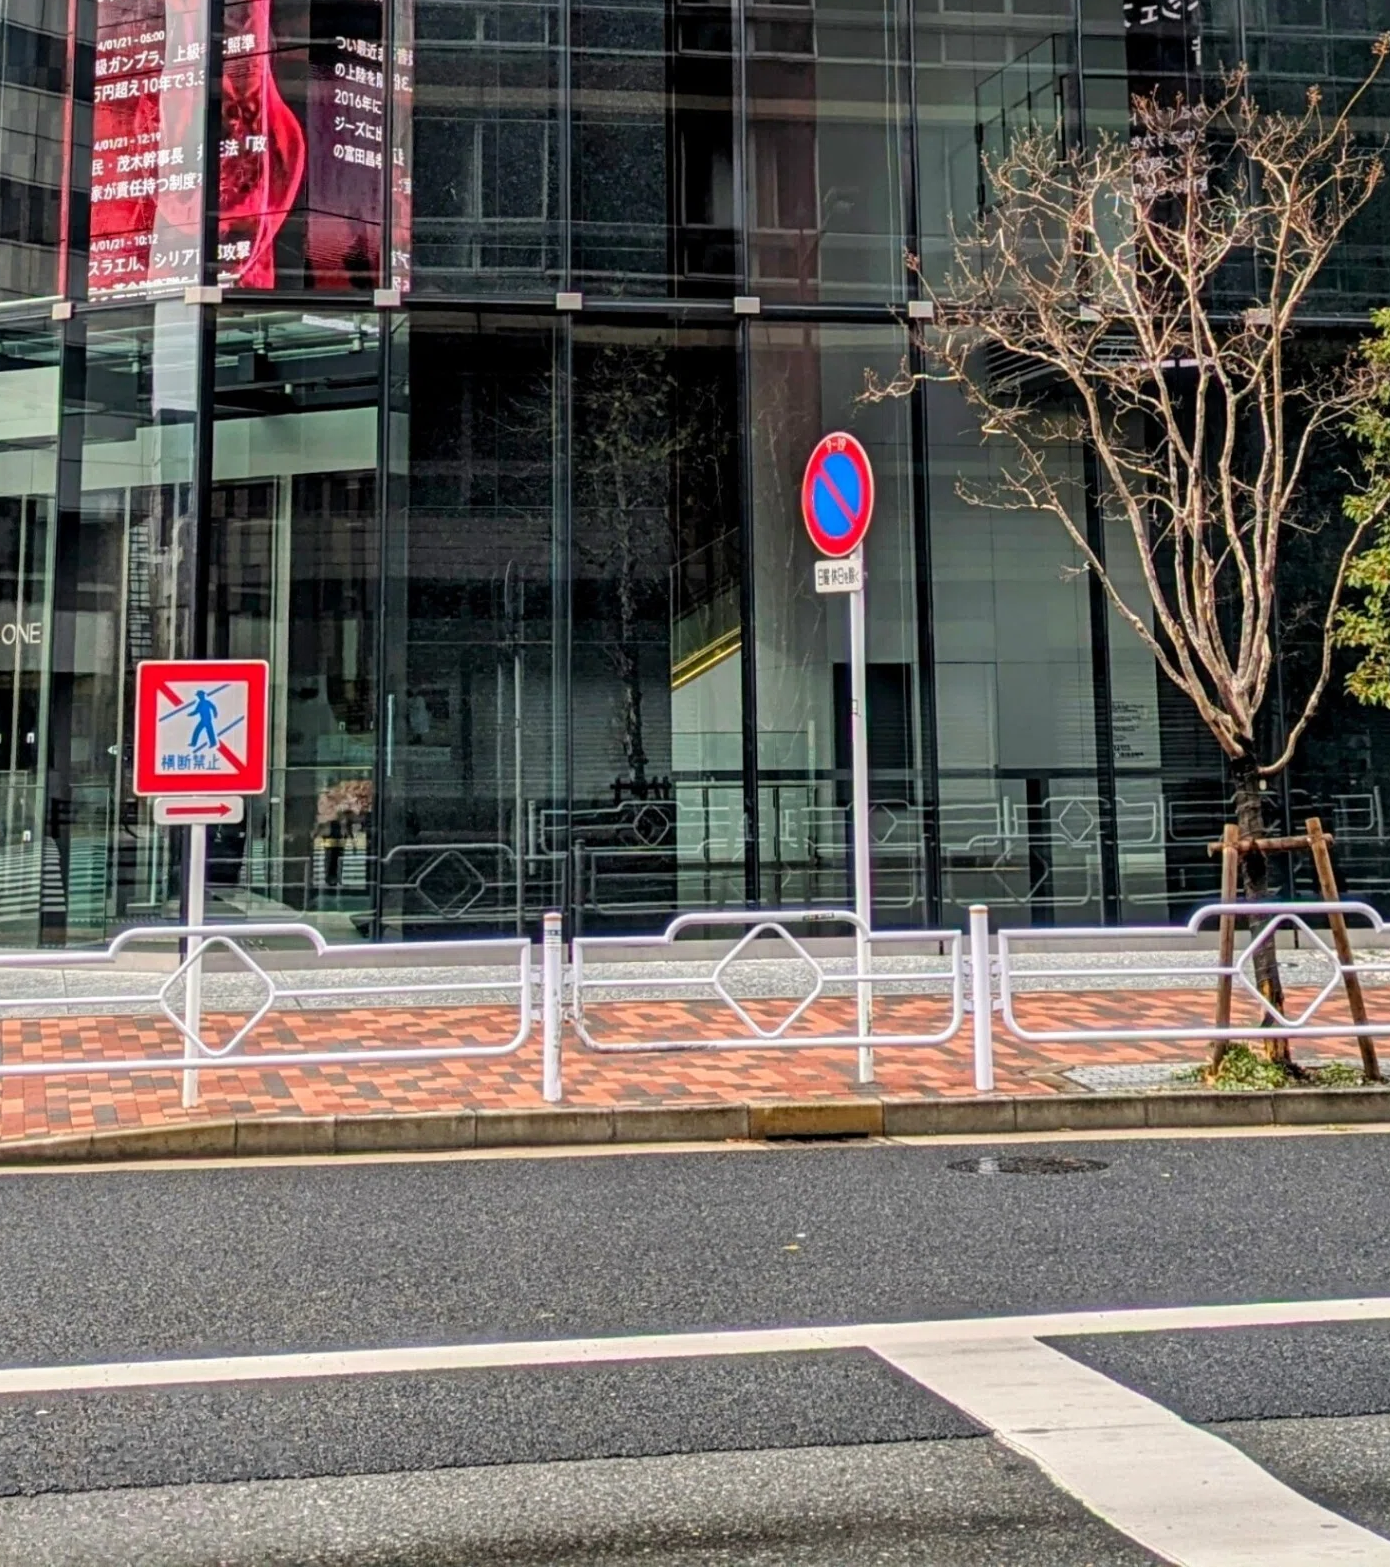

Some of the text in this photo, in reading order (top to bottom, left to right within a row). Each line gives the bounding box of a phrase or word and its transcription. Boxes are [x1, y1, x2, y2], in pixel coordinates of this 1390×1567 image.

[140, 30, 165, 44] 05:00
[88, 248, 200, 277] スラエル、シリア
[1, 622, 42, 645] ONE
[161, 753, 221, 771] 横断禁止
